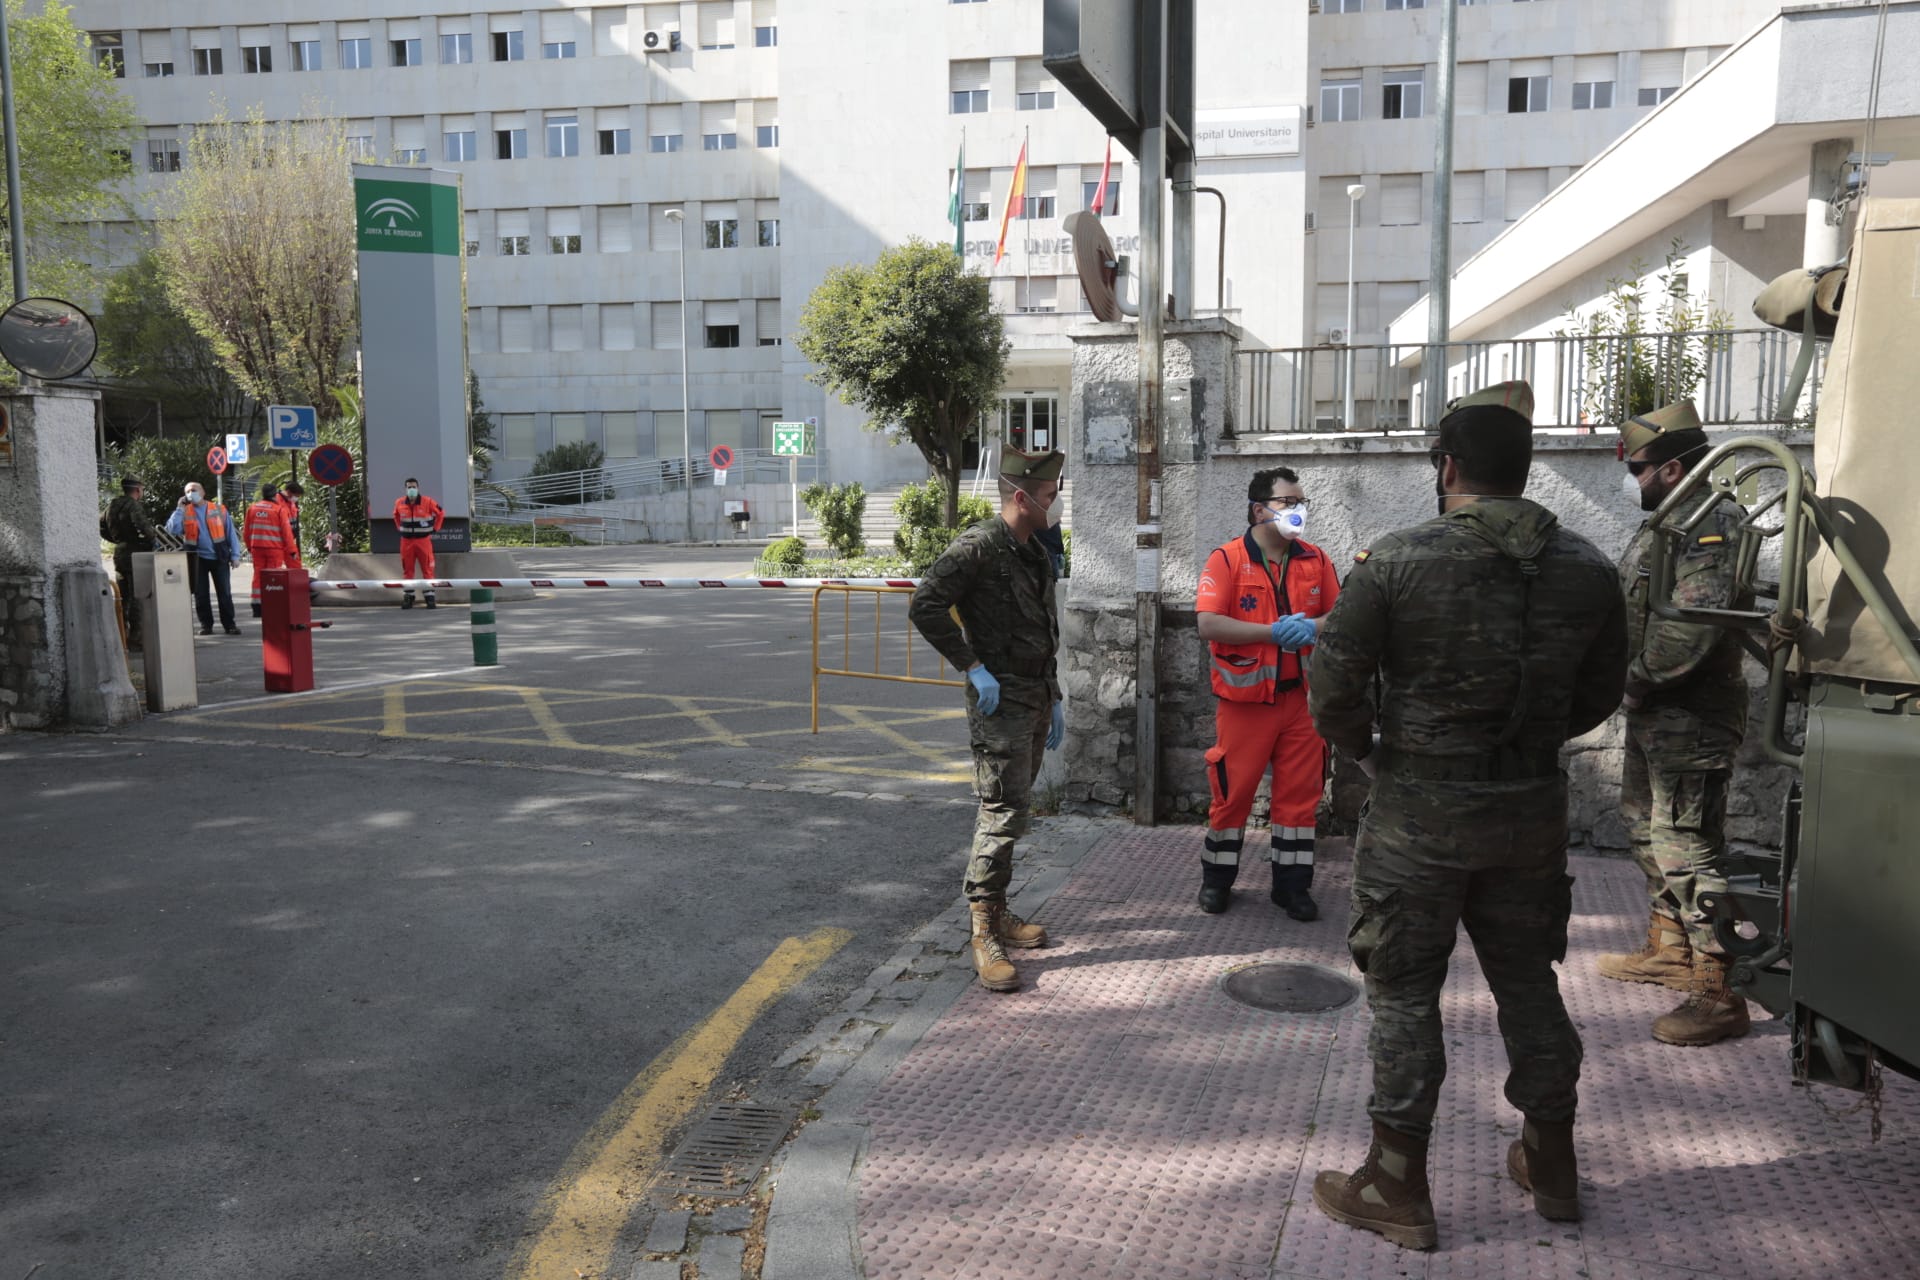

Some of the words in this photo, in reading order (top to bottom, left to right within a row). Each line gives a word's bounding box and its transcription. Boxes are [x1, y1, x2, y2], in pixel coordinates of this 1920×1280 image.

[1196, 129, 1224, 141] spital
[1228, 127, 1292, 139] Universitario
[364, 227, 382, 236] JUNTA
[384, 228, 391, 237] DE
[272, 408, 299, 439] P
[228, 437, 239, 457] P
